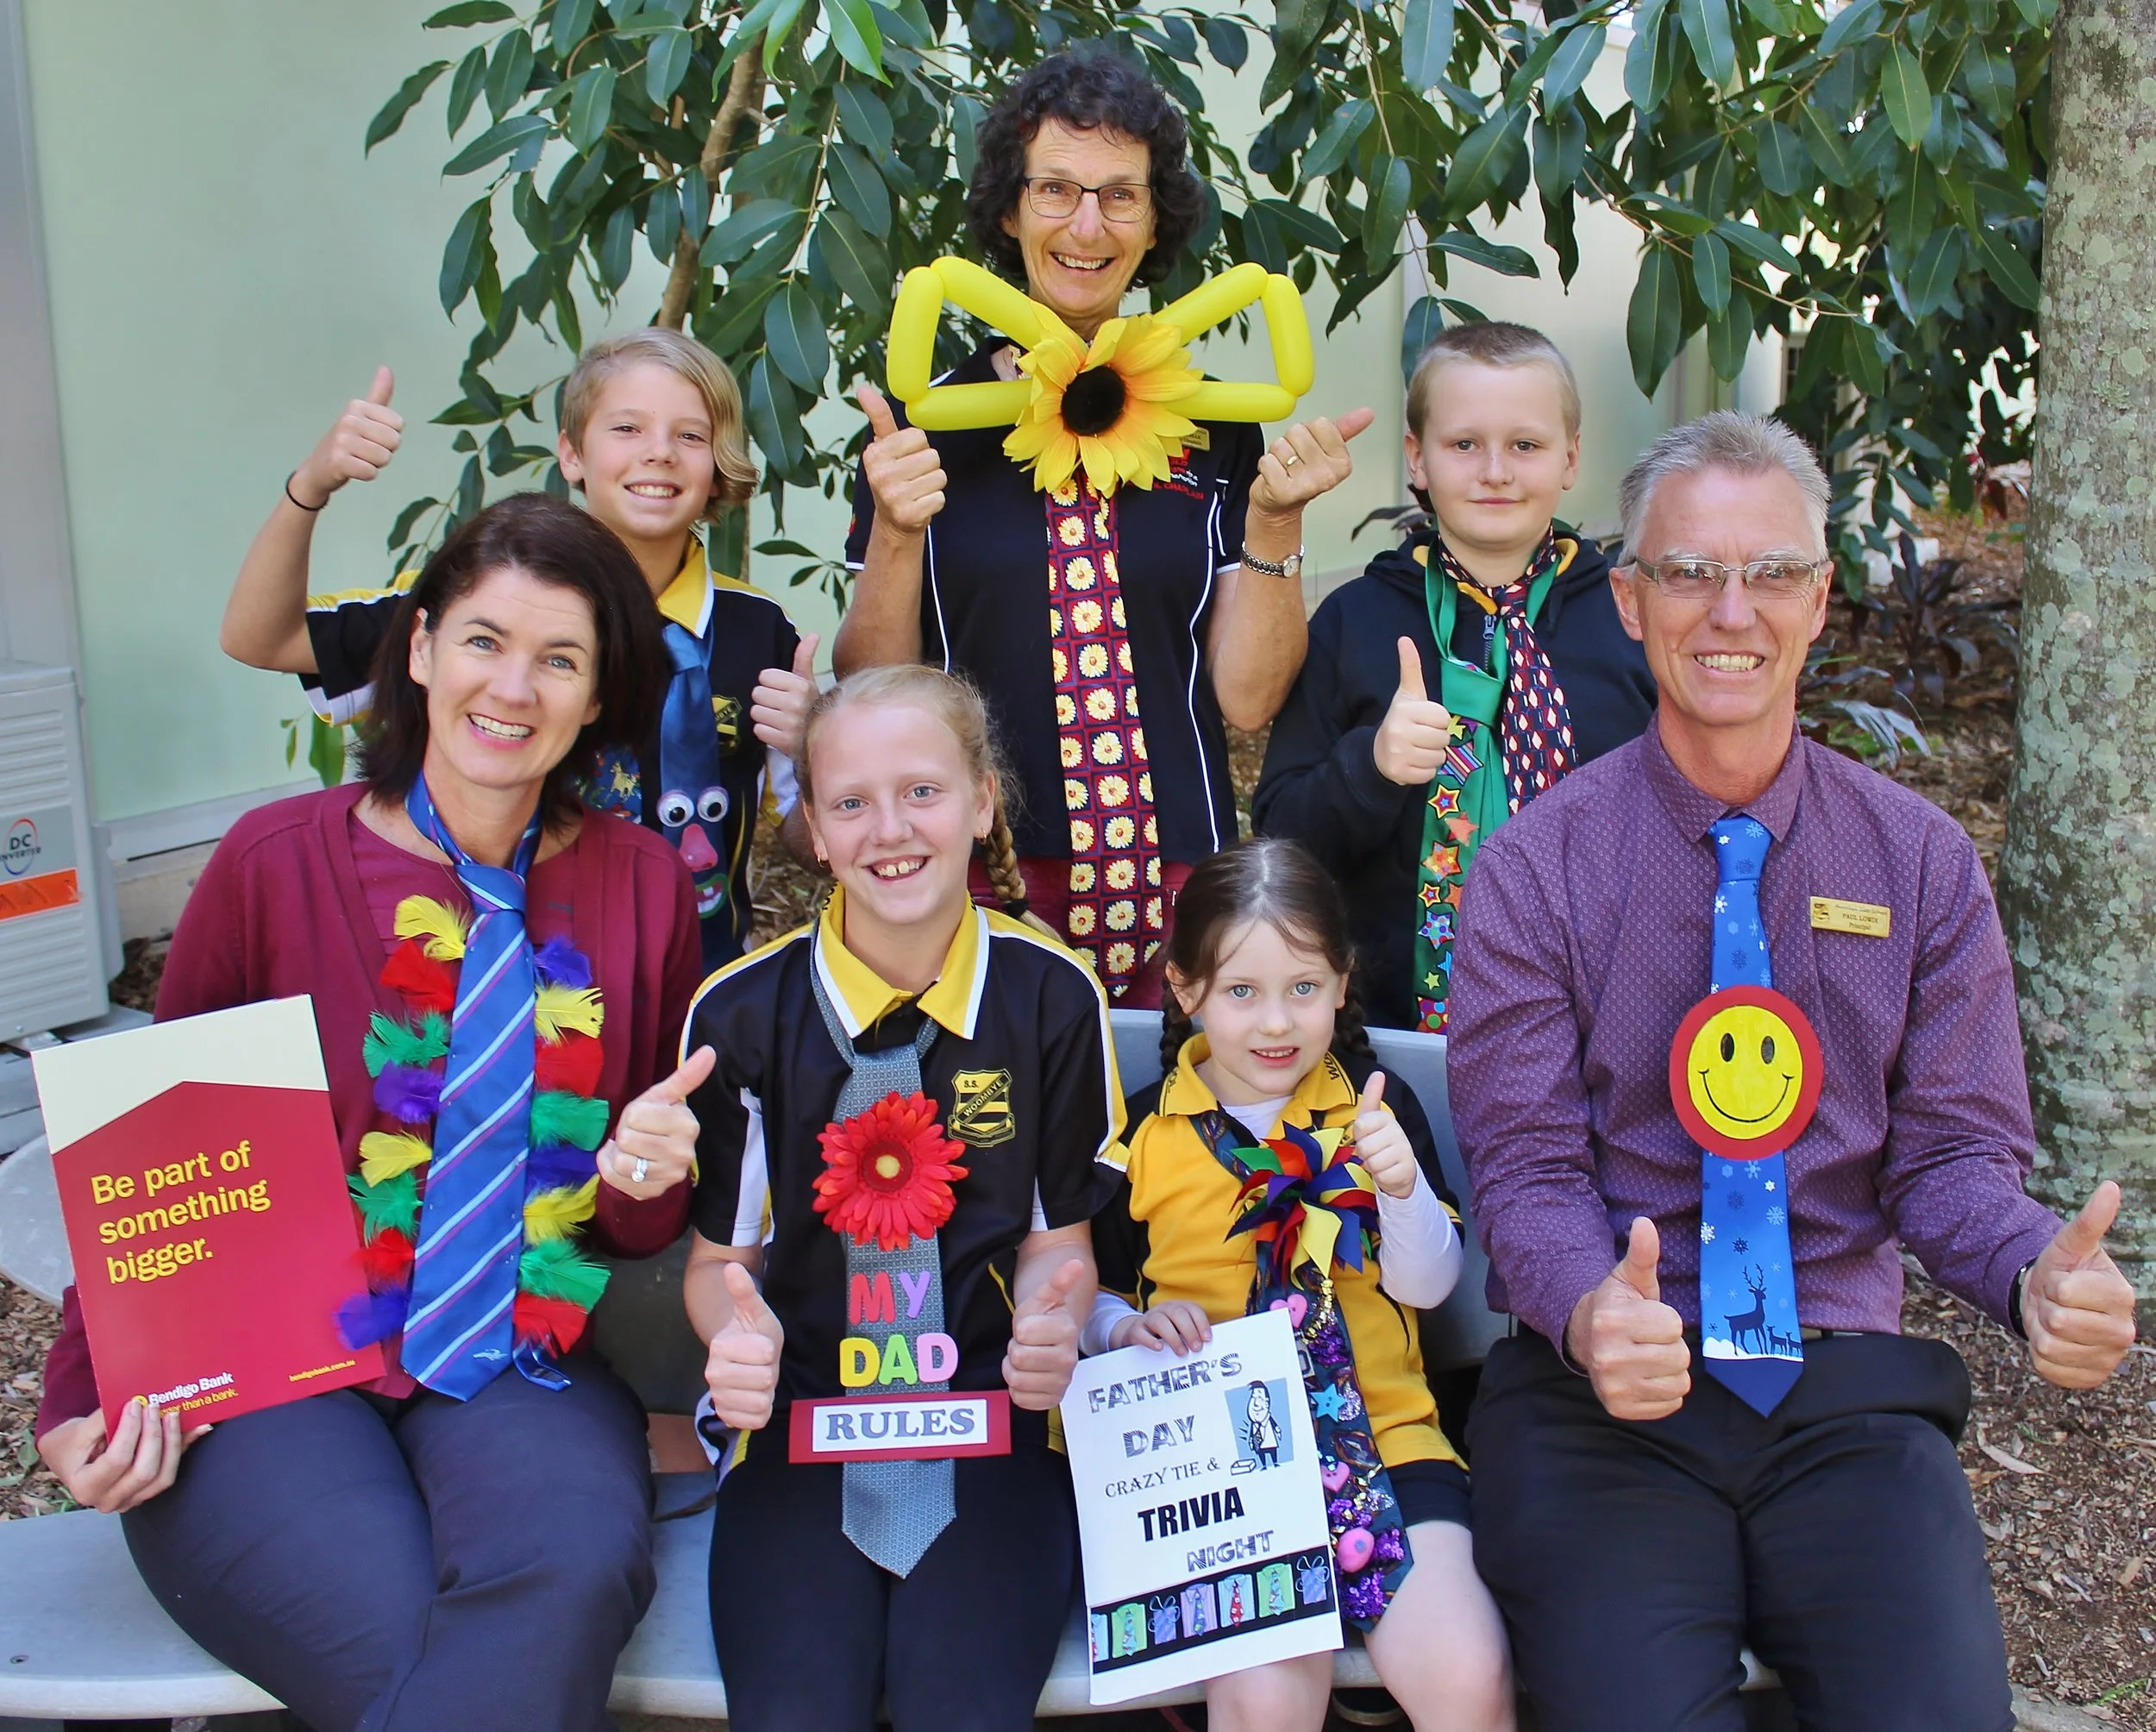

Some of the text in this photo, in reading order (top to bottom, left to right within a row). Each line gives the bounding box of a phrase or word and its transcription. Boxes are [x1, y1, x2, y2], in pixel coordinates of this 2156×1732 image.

[9, 833, 32, 850] DC
[1842, 913, 1858, 921] PAUL
[962, 1079, 1004, 1118] WOOMBYE
[91, 1139, 253, 1205] Be part of
[98, 1179, 273, 1245] something
[106, 1236, 214, 1283] bigger.
[849, 1270, 931, 1326] MY
[838, 1332, 959, 1388] DAD
[147, 1371, 235, 1405] Bendigo Bank
[181, 1398, 205, 1412] than
[204, 1396, 213, 1405] a
[212, 1388, 240, 1403] bank.
[1087, 1352, 1243, 1414] FATHER'S
[826, 1408, 975, 1440] RULES
[1122, 1415, 1195, 1459] DAY
[1105, 1456, 1220, 1498] CRAZY TIE &
[1138, 1486, 1245, 1542] TRIVIA
[1187, 1529, 1275, 1573] NIGHT
